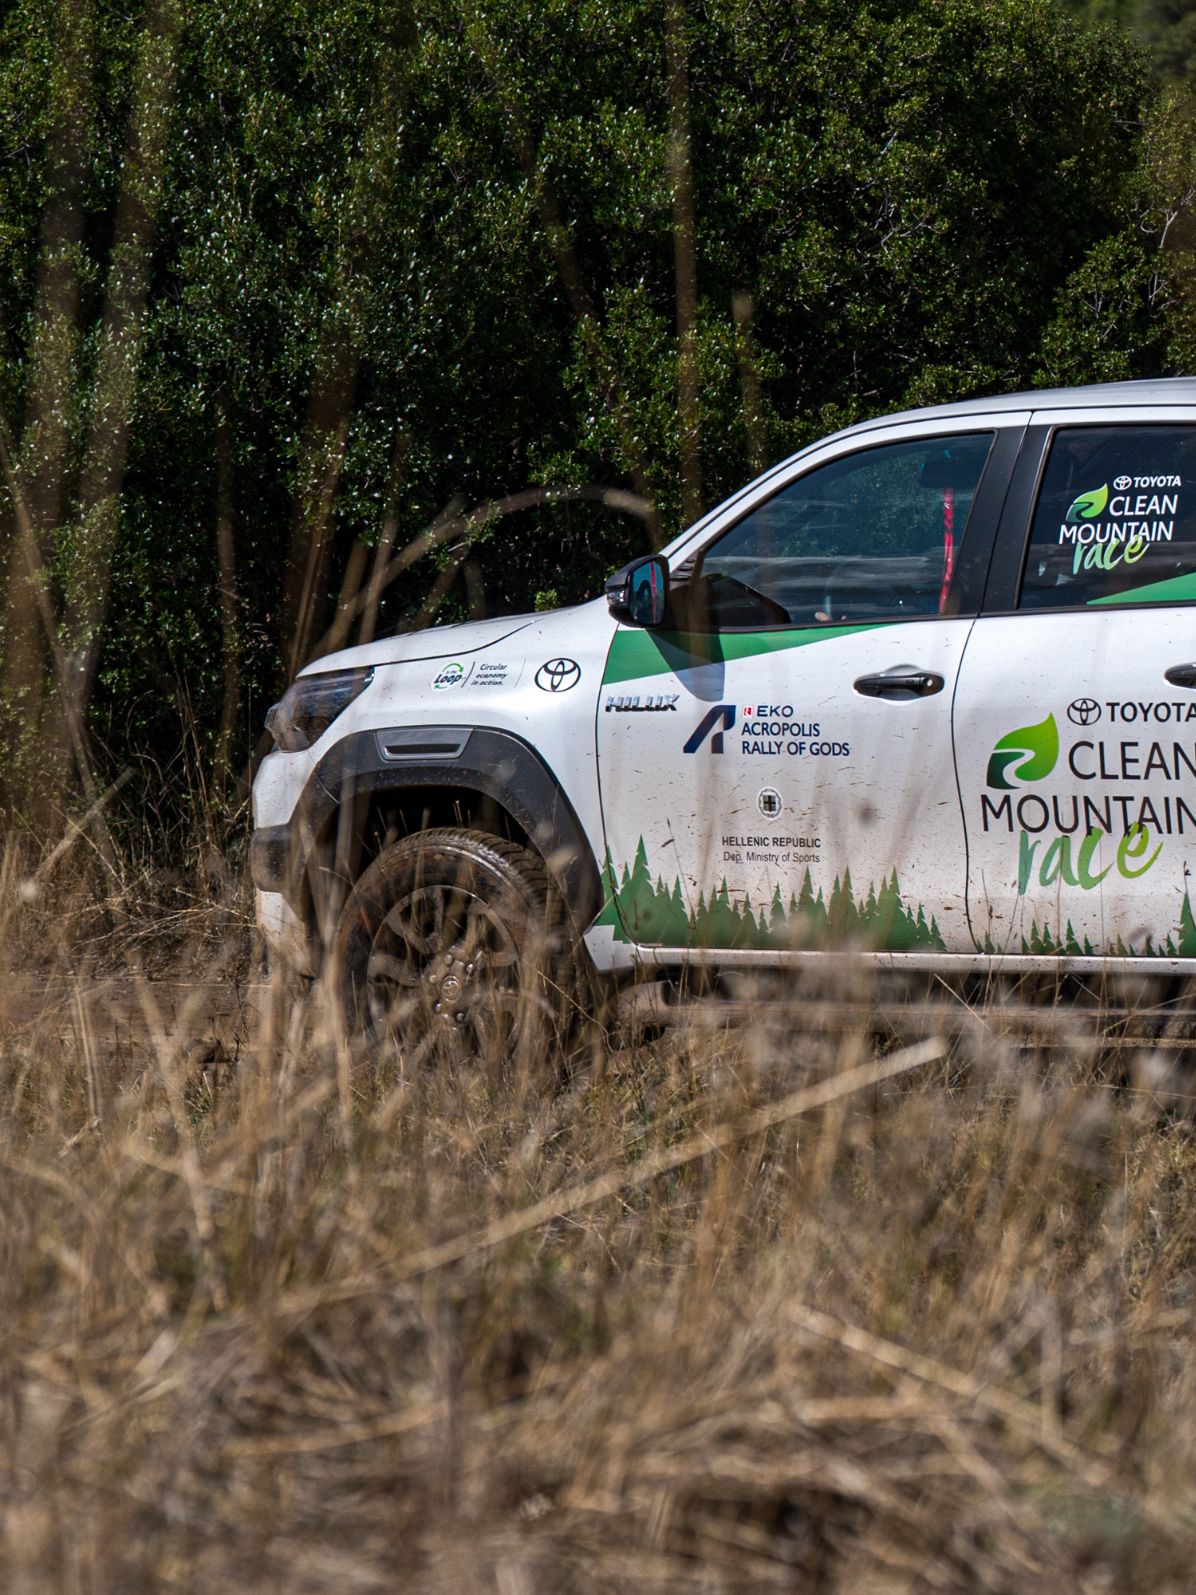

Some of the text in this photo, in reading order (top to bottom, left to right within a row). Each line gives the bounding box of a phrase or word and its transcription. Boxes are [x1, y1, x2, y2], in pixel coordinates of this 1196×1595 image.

[1133, 475, 1182, 488] TOYOTA
[1109, 494, 1178, 516] CLEAN
[1059, 520, 1174, 544] MOUNTAIN
[1072, 534, 1150, 575] race
[480, 663, 508, 671] Circular
[434, 673, 463, 686] Loop
[475, 672, 508, 680] economy
[605, 694, 680, 712] HILUX
[757, 705, 794, 718] EKO
[741, 722, 821, 737] ACROPOLIS
[742, 741, 850, 757] RALLY OF GODS
[722, 836, 821, 848] HELLENIC REPUBLIC
[746, 851, 779, 863] Ministry
[782, 852, 790, 862] of
[792, 853, 821, 864] Sports
[1018, 822, 1164, 896] race
